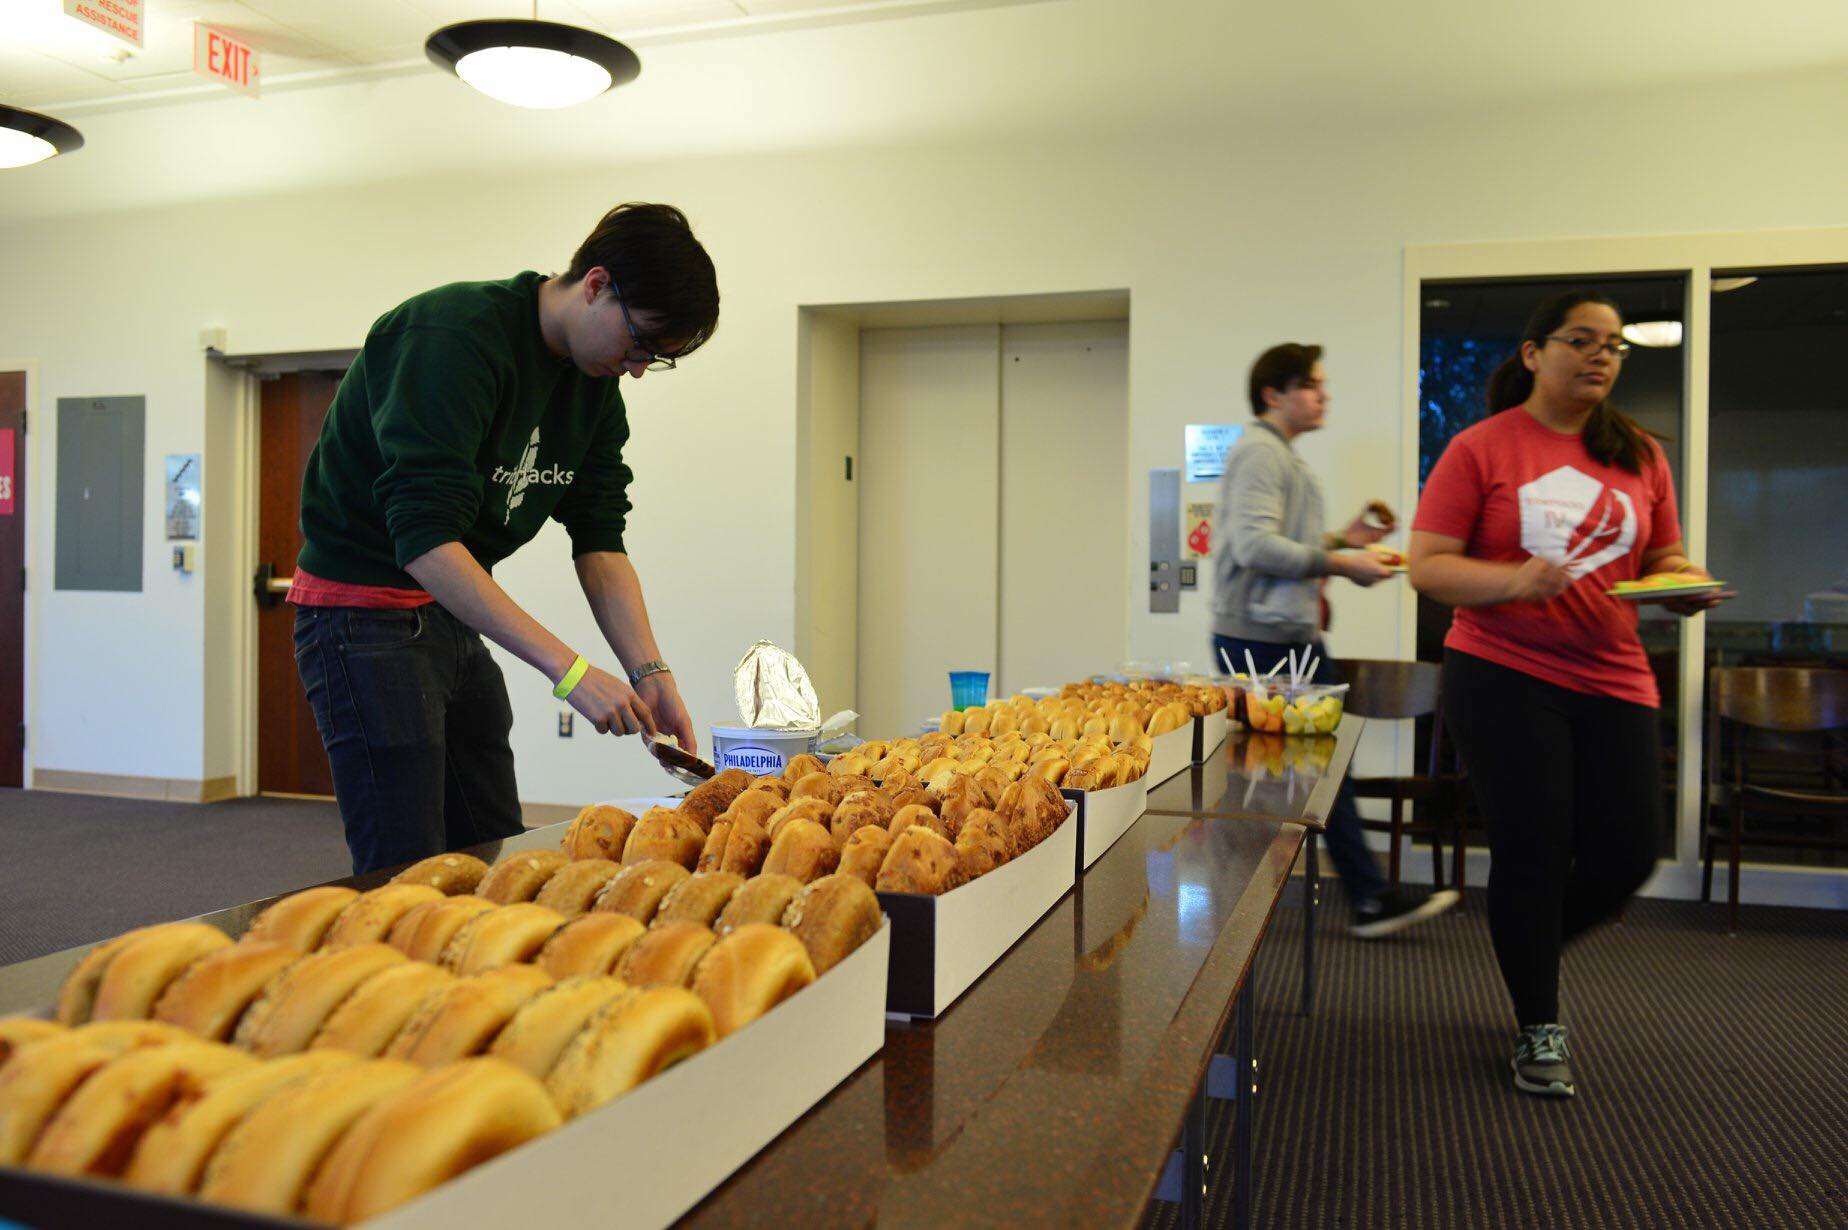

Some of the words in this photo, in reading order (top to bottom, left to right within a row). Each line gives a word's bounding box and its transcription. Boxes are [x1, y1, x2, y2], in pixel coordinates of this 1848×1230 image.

[76, 4, 138, 41] ASSISTANCE
[208, 32, 251, 86] EXIT
[723, 753, 782, 768] PHILADELPHIA
